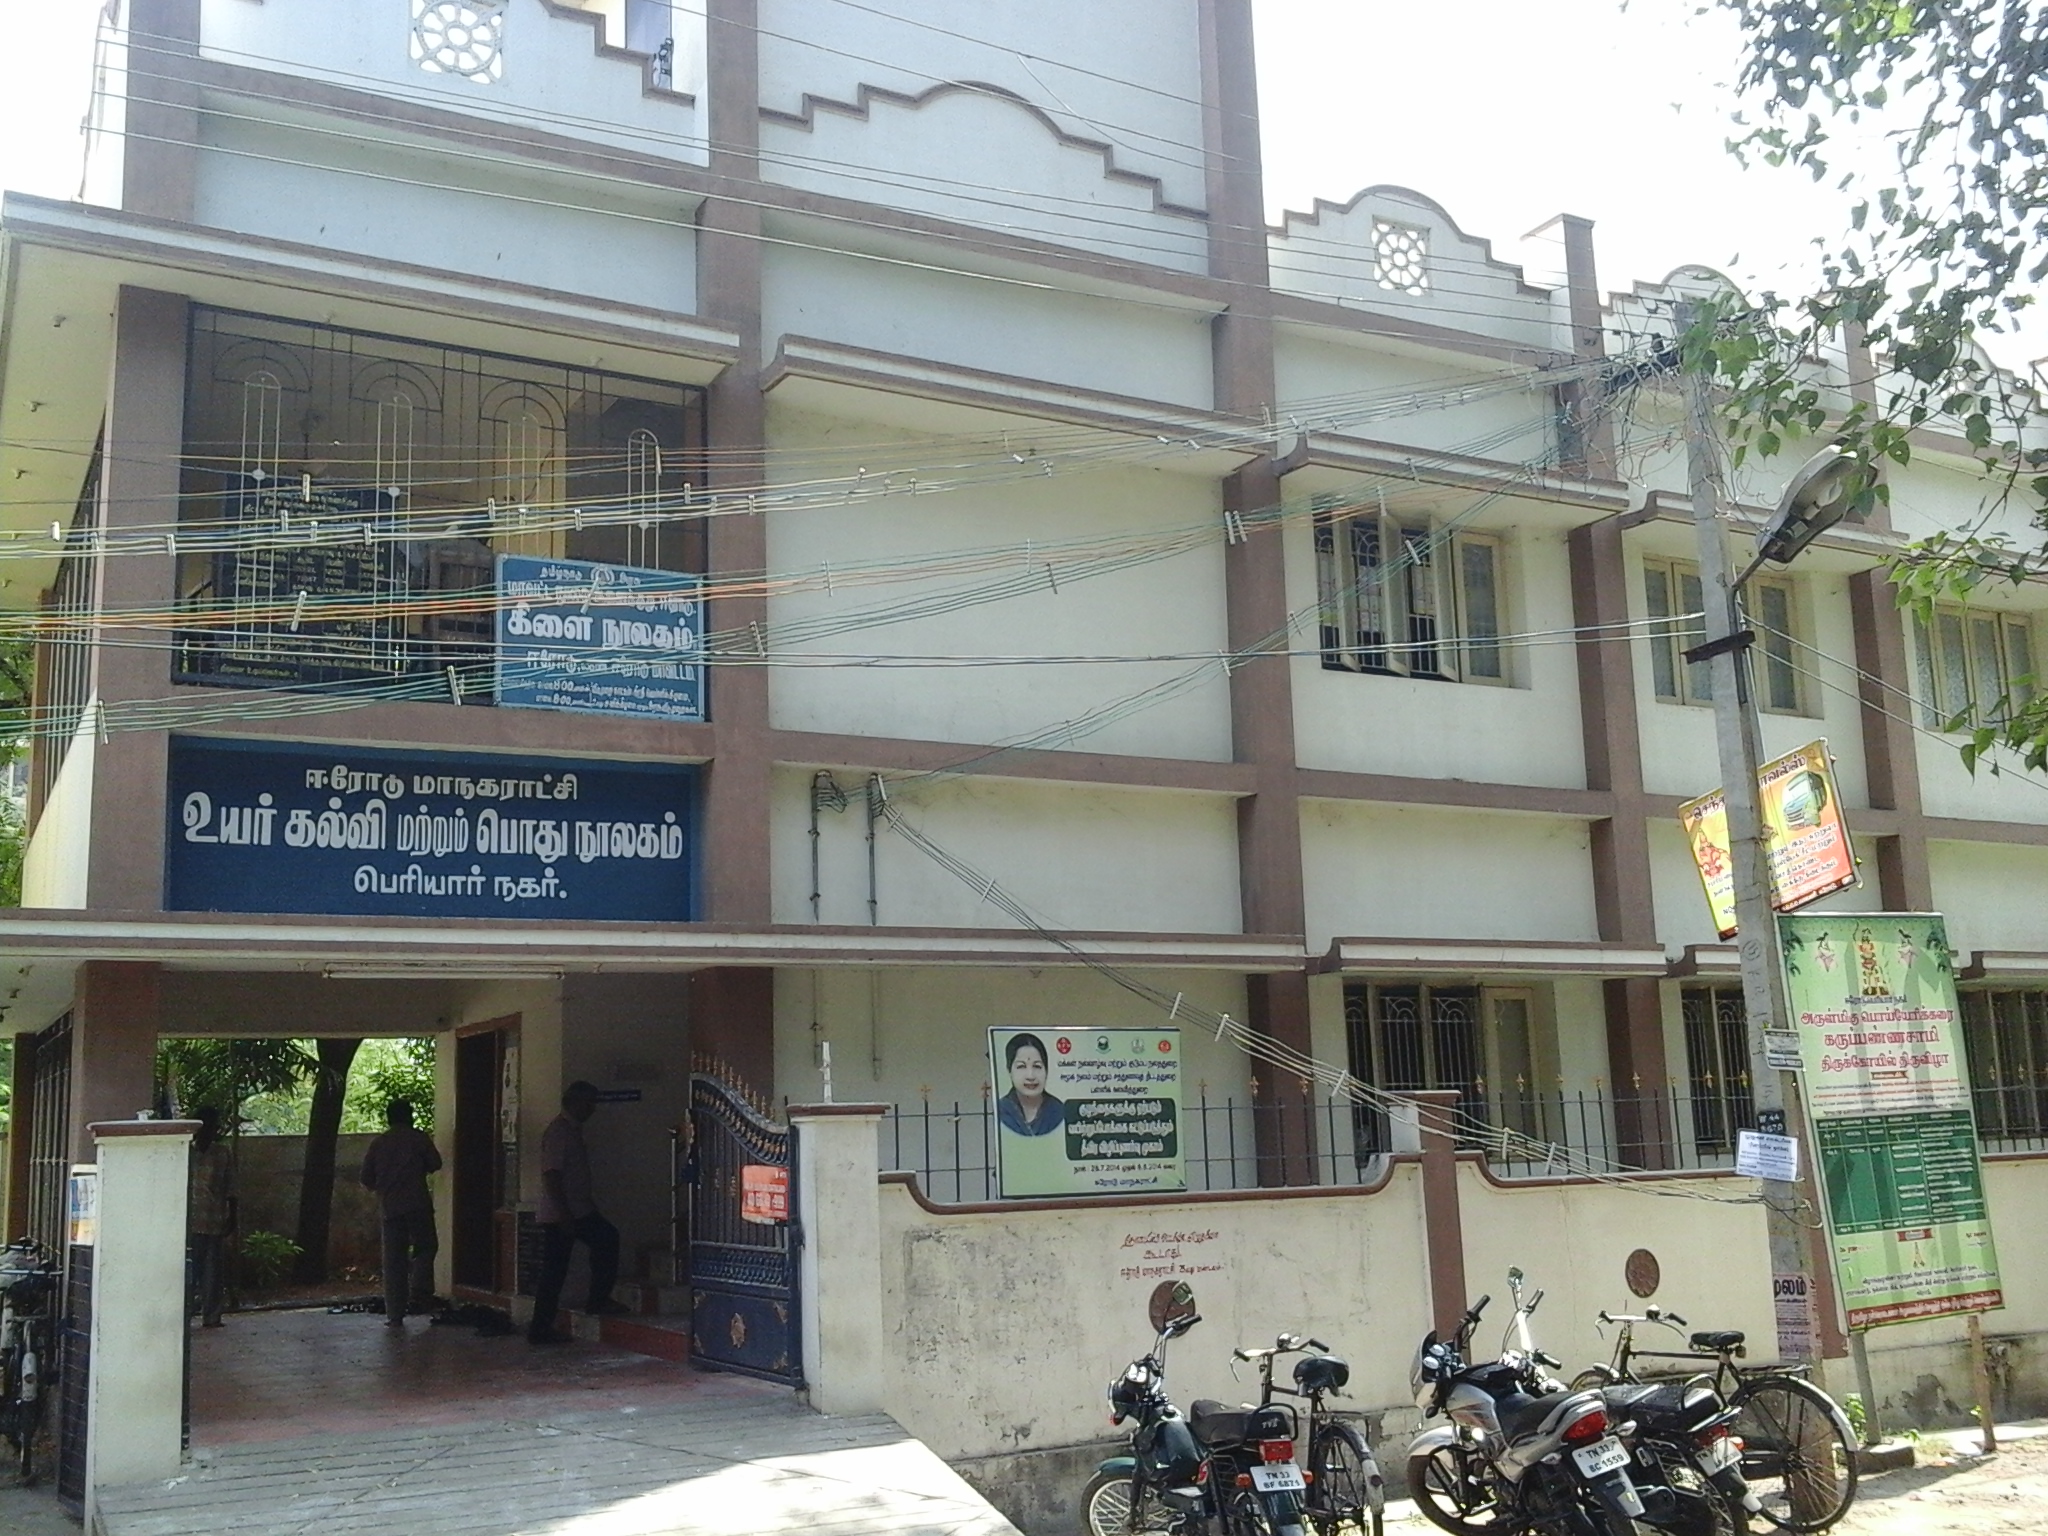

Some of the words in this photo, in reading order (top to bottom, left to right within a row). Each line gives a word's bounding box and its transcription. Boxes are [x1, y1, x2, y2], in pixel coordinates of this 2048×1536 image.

[507, 602, 593, 641] கிளை
[602, 618, 693, 650] நூலகம்
[306, 765, 404, 799] ஈரோடு
[413, 774, 577, 801] மாநகராட்சி
[183, 791, 277, 845] உயர்
[285, 796, 387, 850] கல்வி
[396, 805, 468, 857] மற்றும்
[476, 809, 567, 863] பொது
[575, 811, 684, 864] நூலகம்
[354, 865, 483, 896] பெரியார்
[493, 867, 568, 901] நகர்.
[1801, 1008, 1859, 1026] அருள்மிகு
[1824, 1025, 1940, 1050] கருப்பண்ணசாமி
[1821, 1050, 1898, 1072] திருக்கோயில்
[1900, 1051, 1949, 1069] திருவிழா
[1602, 1454, 1625, 1468] 1559
